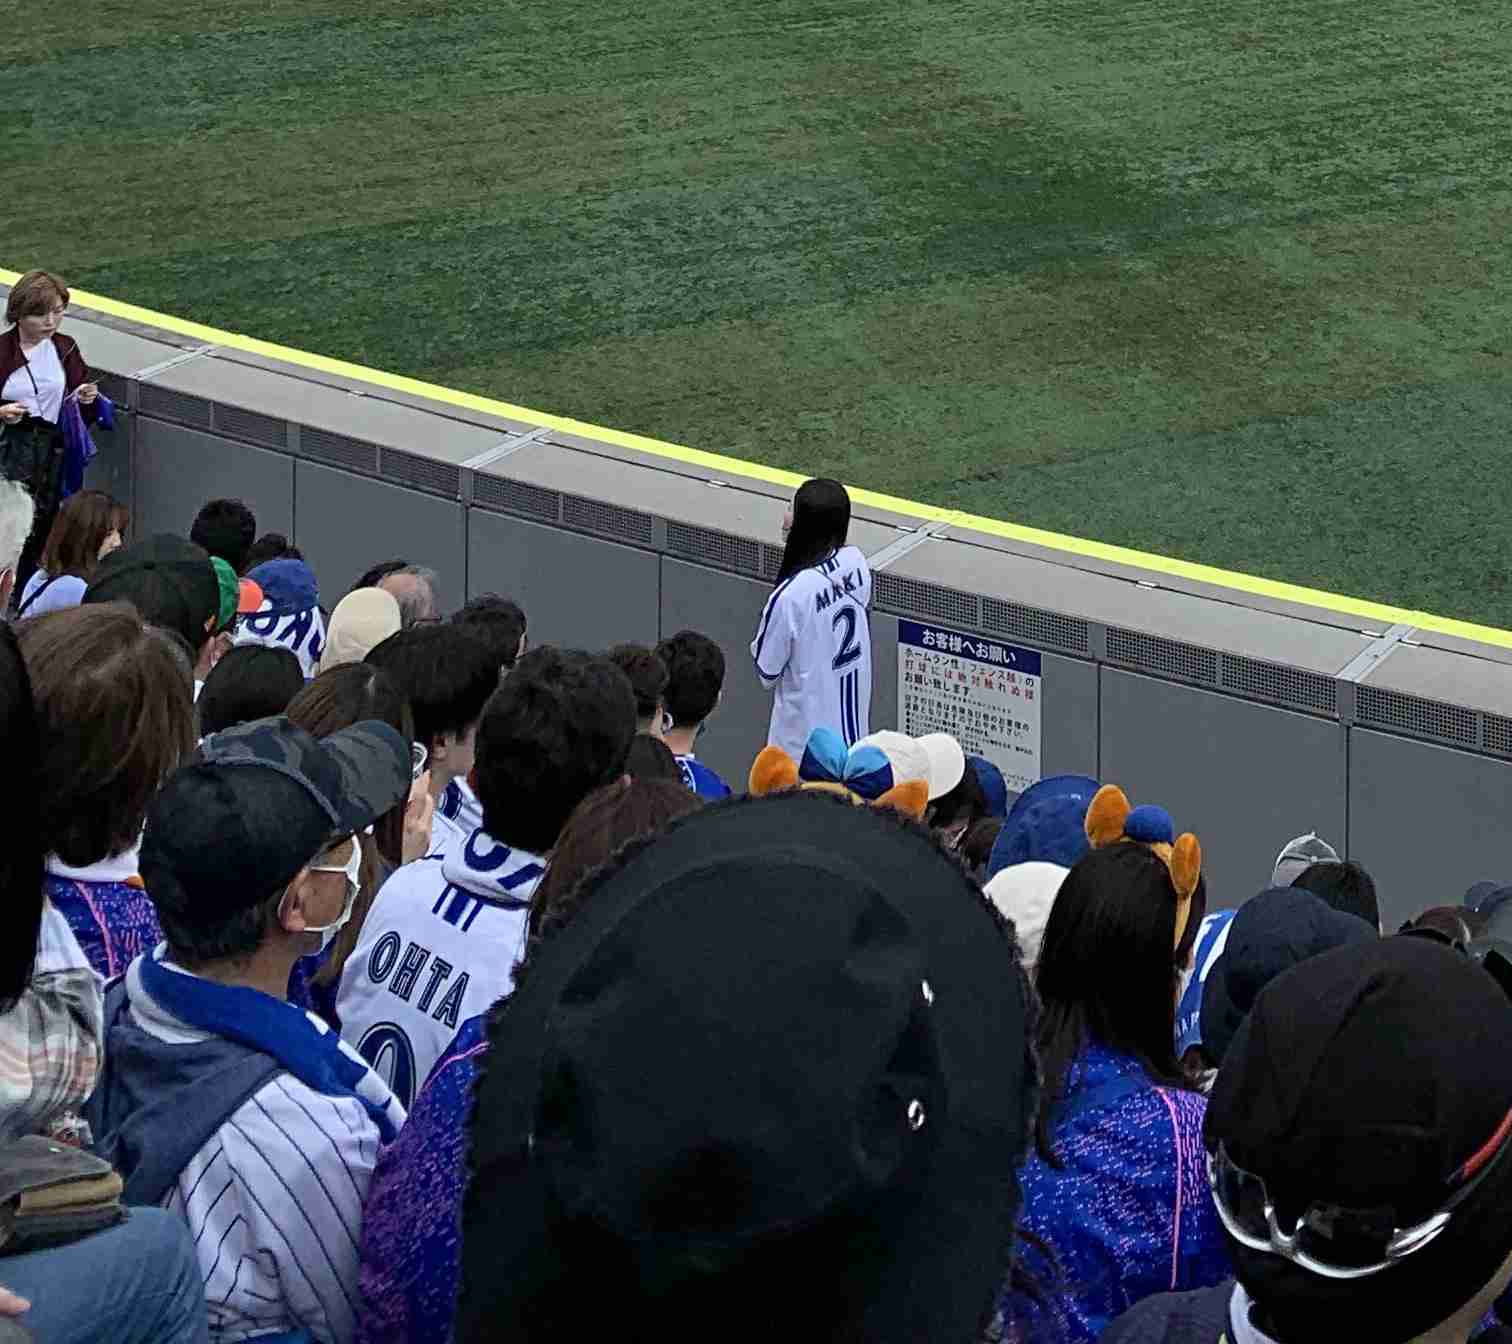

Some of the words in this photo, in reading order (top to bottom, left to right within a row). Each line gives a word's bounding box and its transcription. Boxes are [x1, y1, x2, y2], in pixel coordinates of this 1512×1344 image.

[815, 568, 865, 614] MAKI
[830, 604, 862, 672] 2
[921, 628, 1017, 664] お客様へお願い
[367, 930, 471, 1030] OHTA
